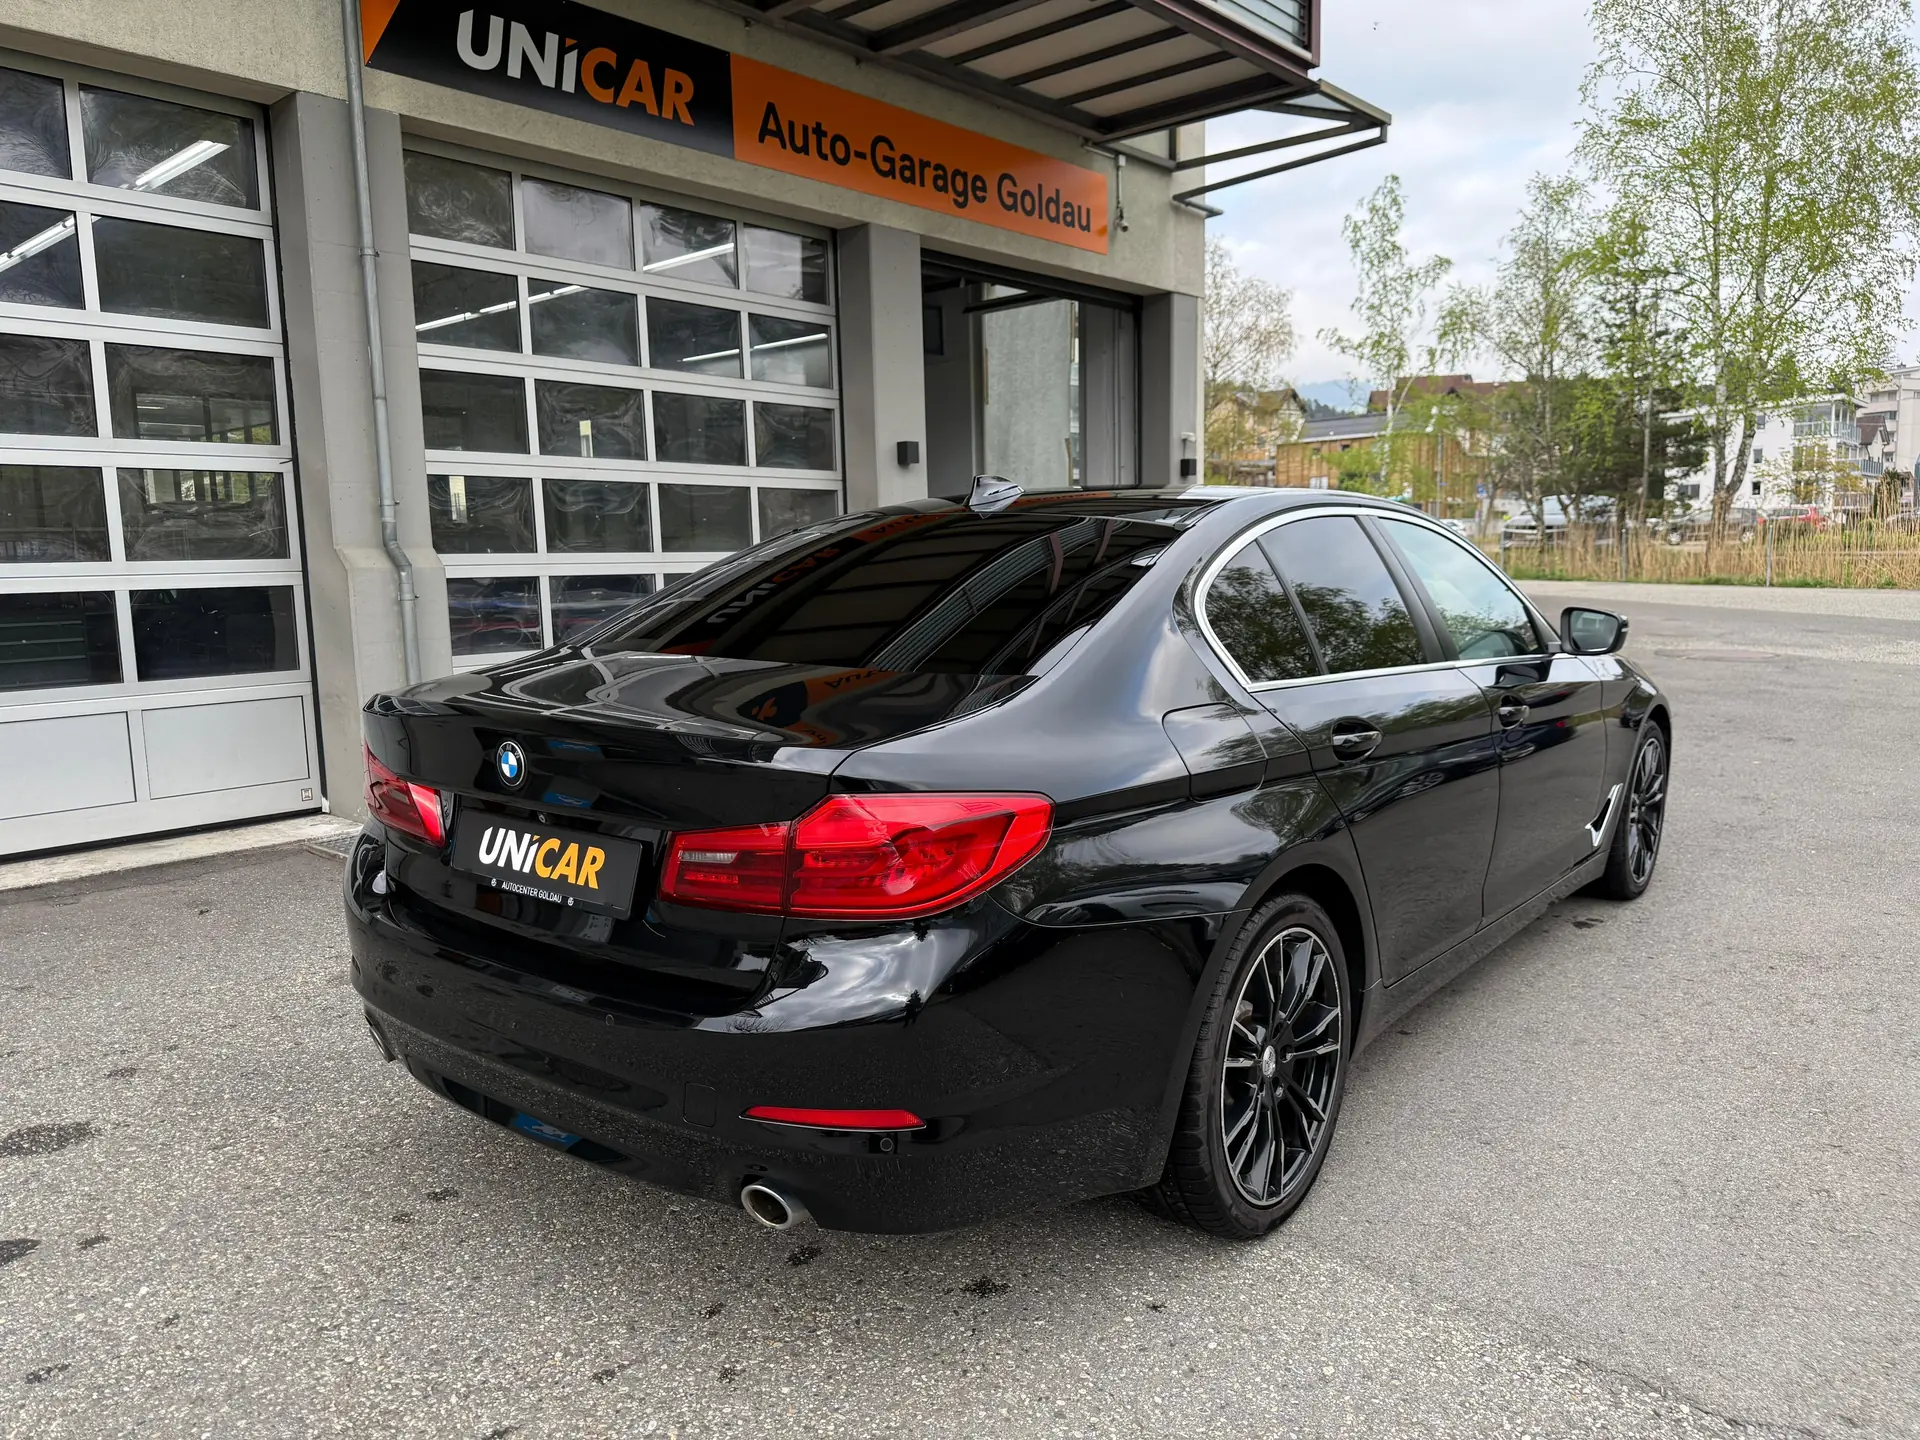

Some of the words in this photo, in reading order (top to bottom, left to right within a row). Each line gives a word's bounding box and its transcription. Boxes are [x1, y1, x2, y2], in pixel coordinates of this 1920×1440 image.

[758, 101, 988, 209] Auto-Garage
[997, 173, 1092, 233] Goldau
[501, 881, 538, 898] AUTOCENTER
[538, 889, 562, 903] GOLDAU
